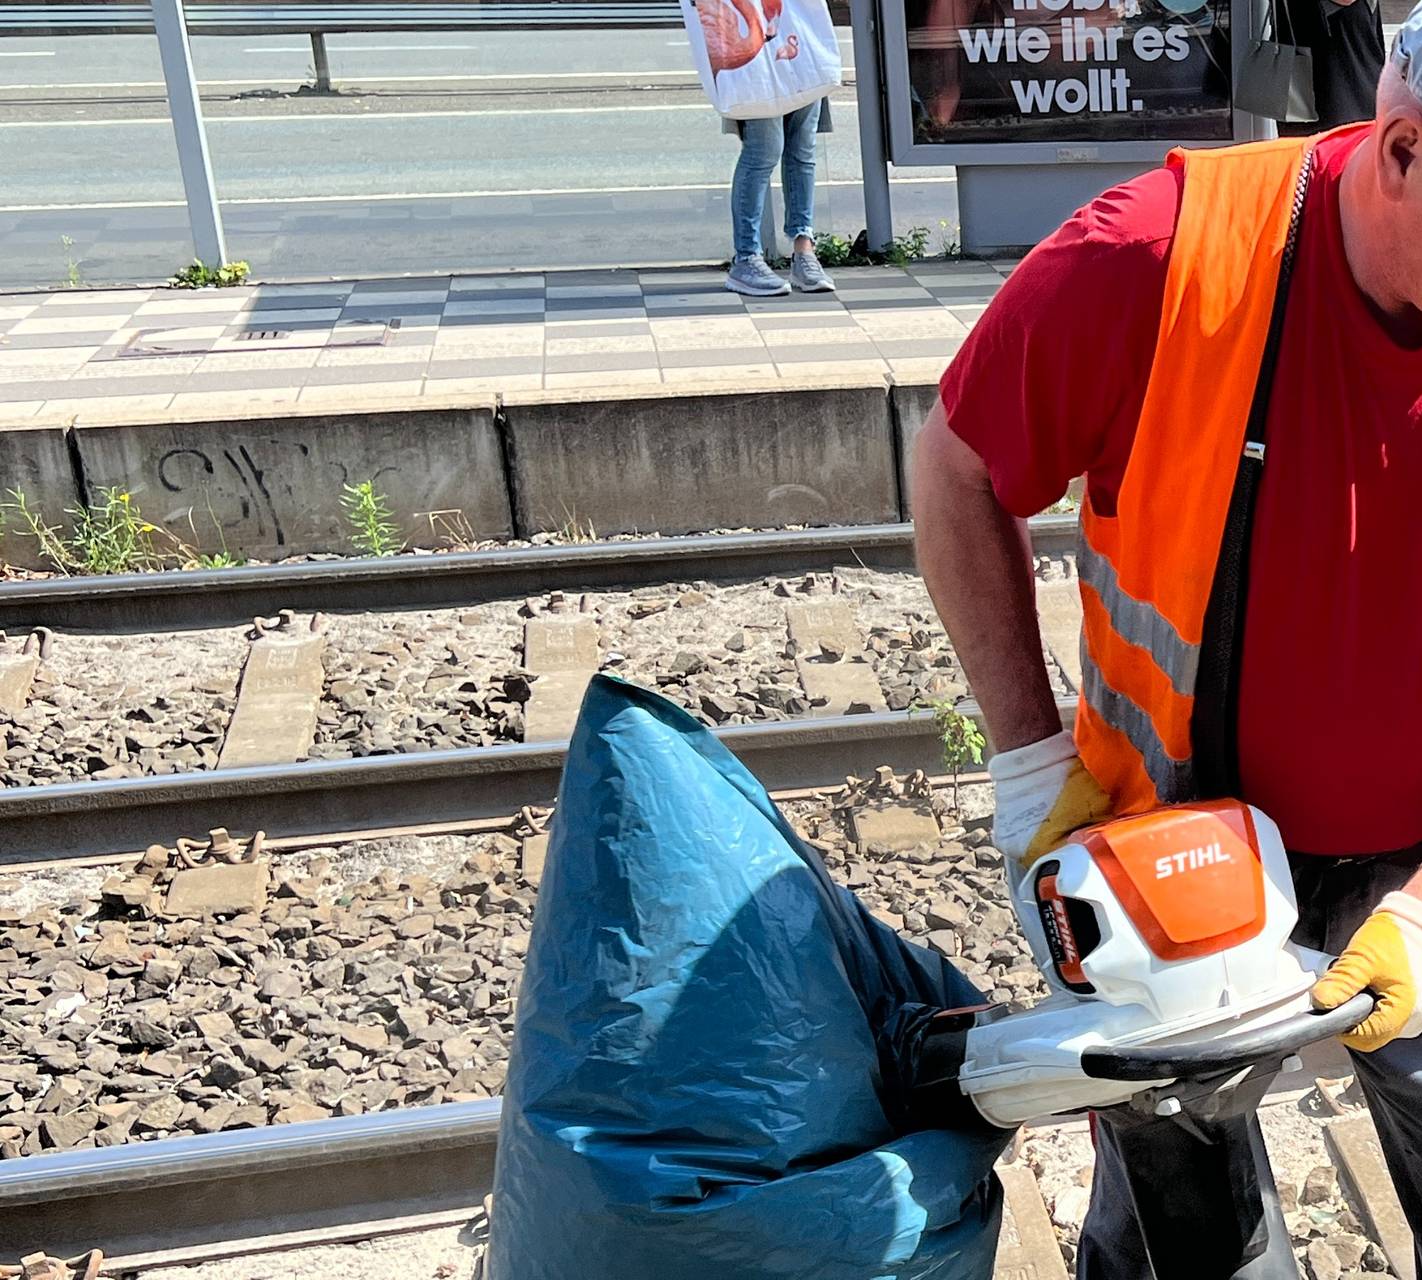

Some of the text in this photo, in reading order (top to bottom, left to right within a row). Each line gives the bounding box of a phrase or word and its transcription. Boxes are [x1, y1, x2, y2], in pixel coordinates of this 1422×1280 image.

[958, 17, 1191, 63] wie ihr es
[1010, 68, 1144, 113] wollt.
[1155, 842, 1231, 880] STIHL
